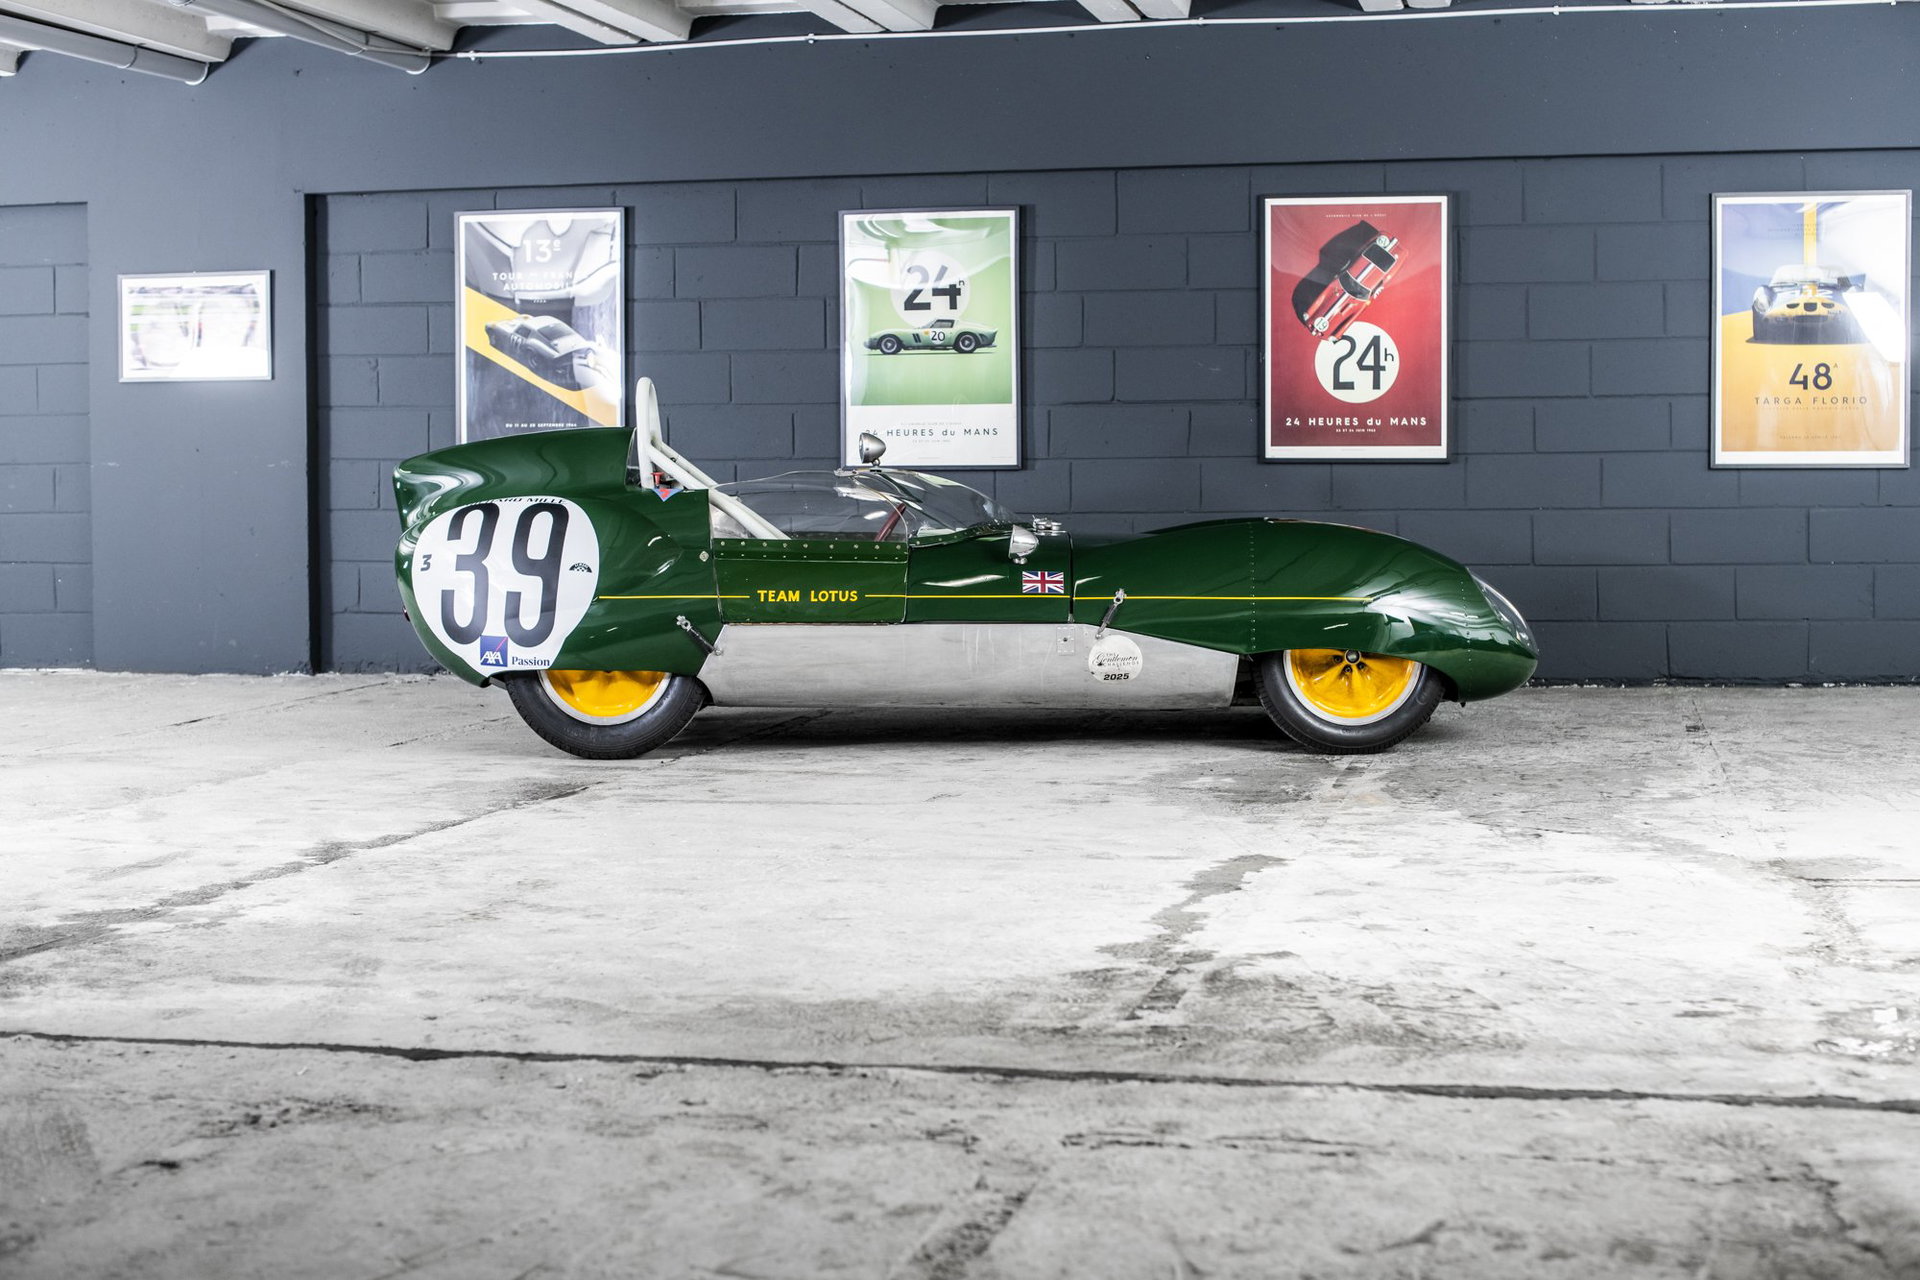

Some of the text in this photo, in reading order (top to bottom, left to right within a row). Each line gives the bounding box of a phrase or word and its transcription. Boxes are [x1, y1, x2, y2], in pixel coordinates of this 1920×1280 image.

[492, 272, 523, 281] TOUR
[931, 330, 946, 342] 20
[1754, 395, 1868, 405] TARGA FLORIO
[1285, 416, 1427, 426] 24 HEURES du MANS
[886, 428, 934, 437] HEURES
[942, 428, 956, 437] du
[963, 427, 999, 436] MANS
[420, 554, 432, 572] 3
[441, 502, 569, 648] 39
[757, 590, 858, 602] TEAM LOTUS
[480, 650, 551, 667] AXA Passion
[1103, 672, 1130, 681] 2025
